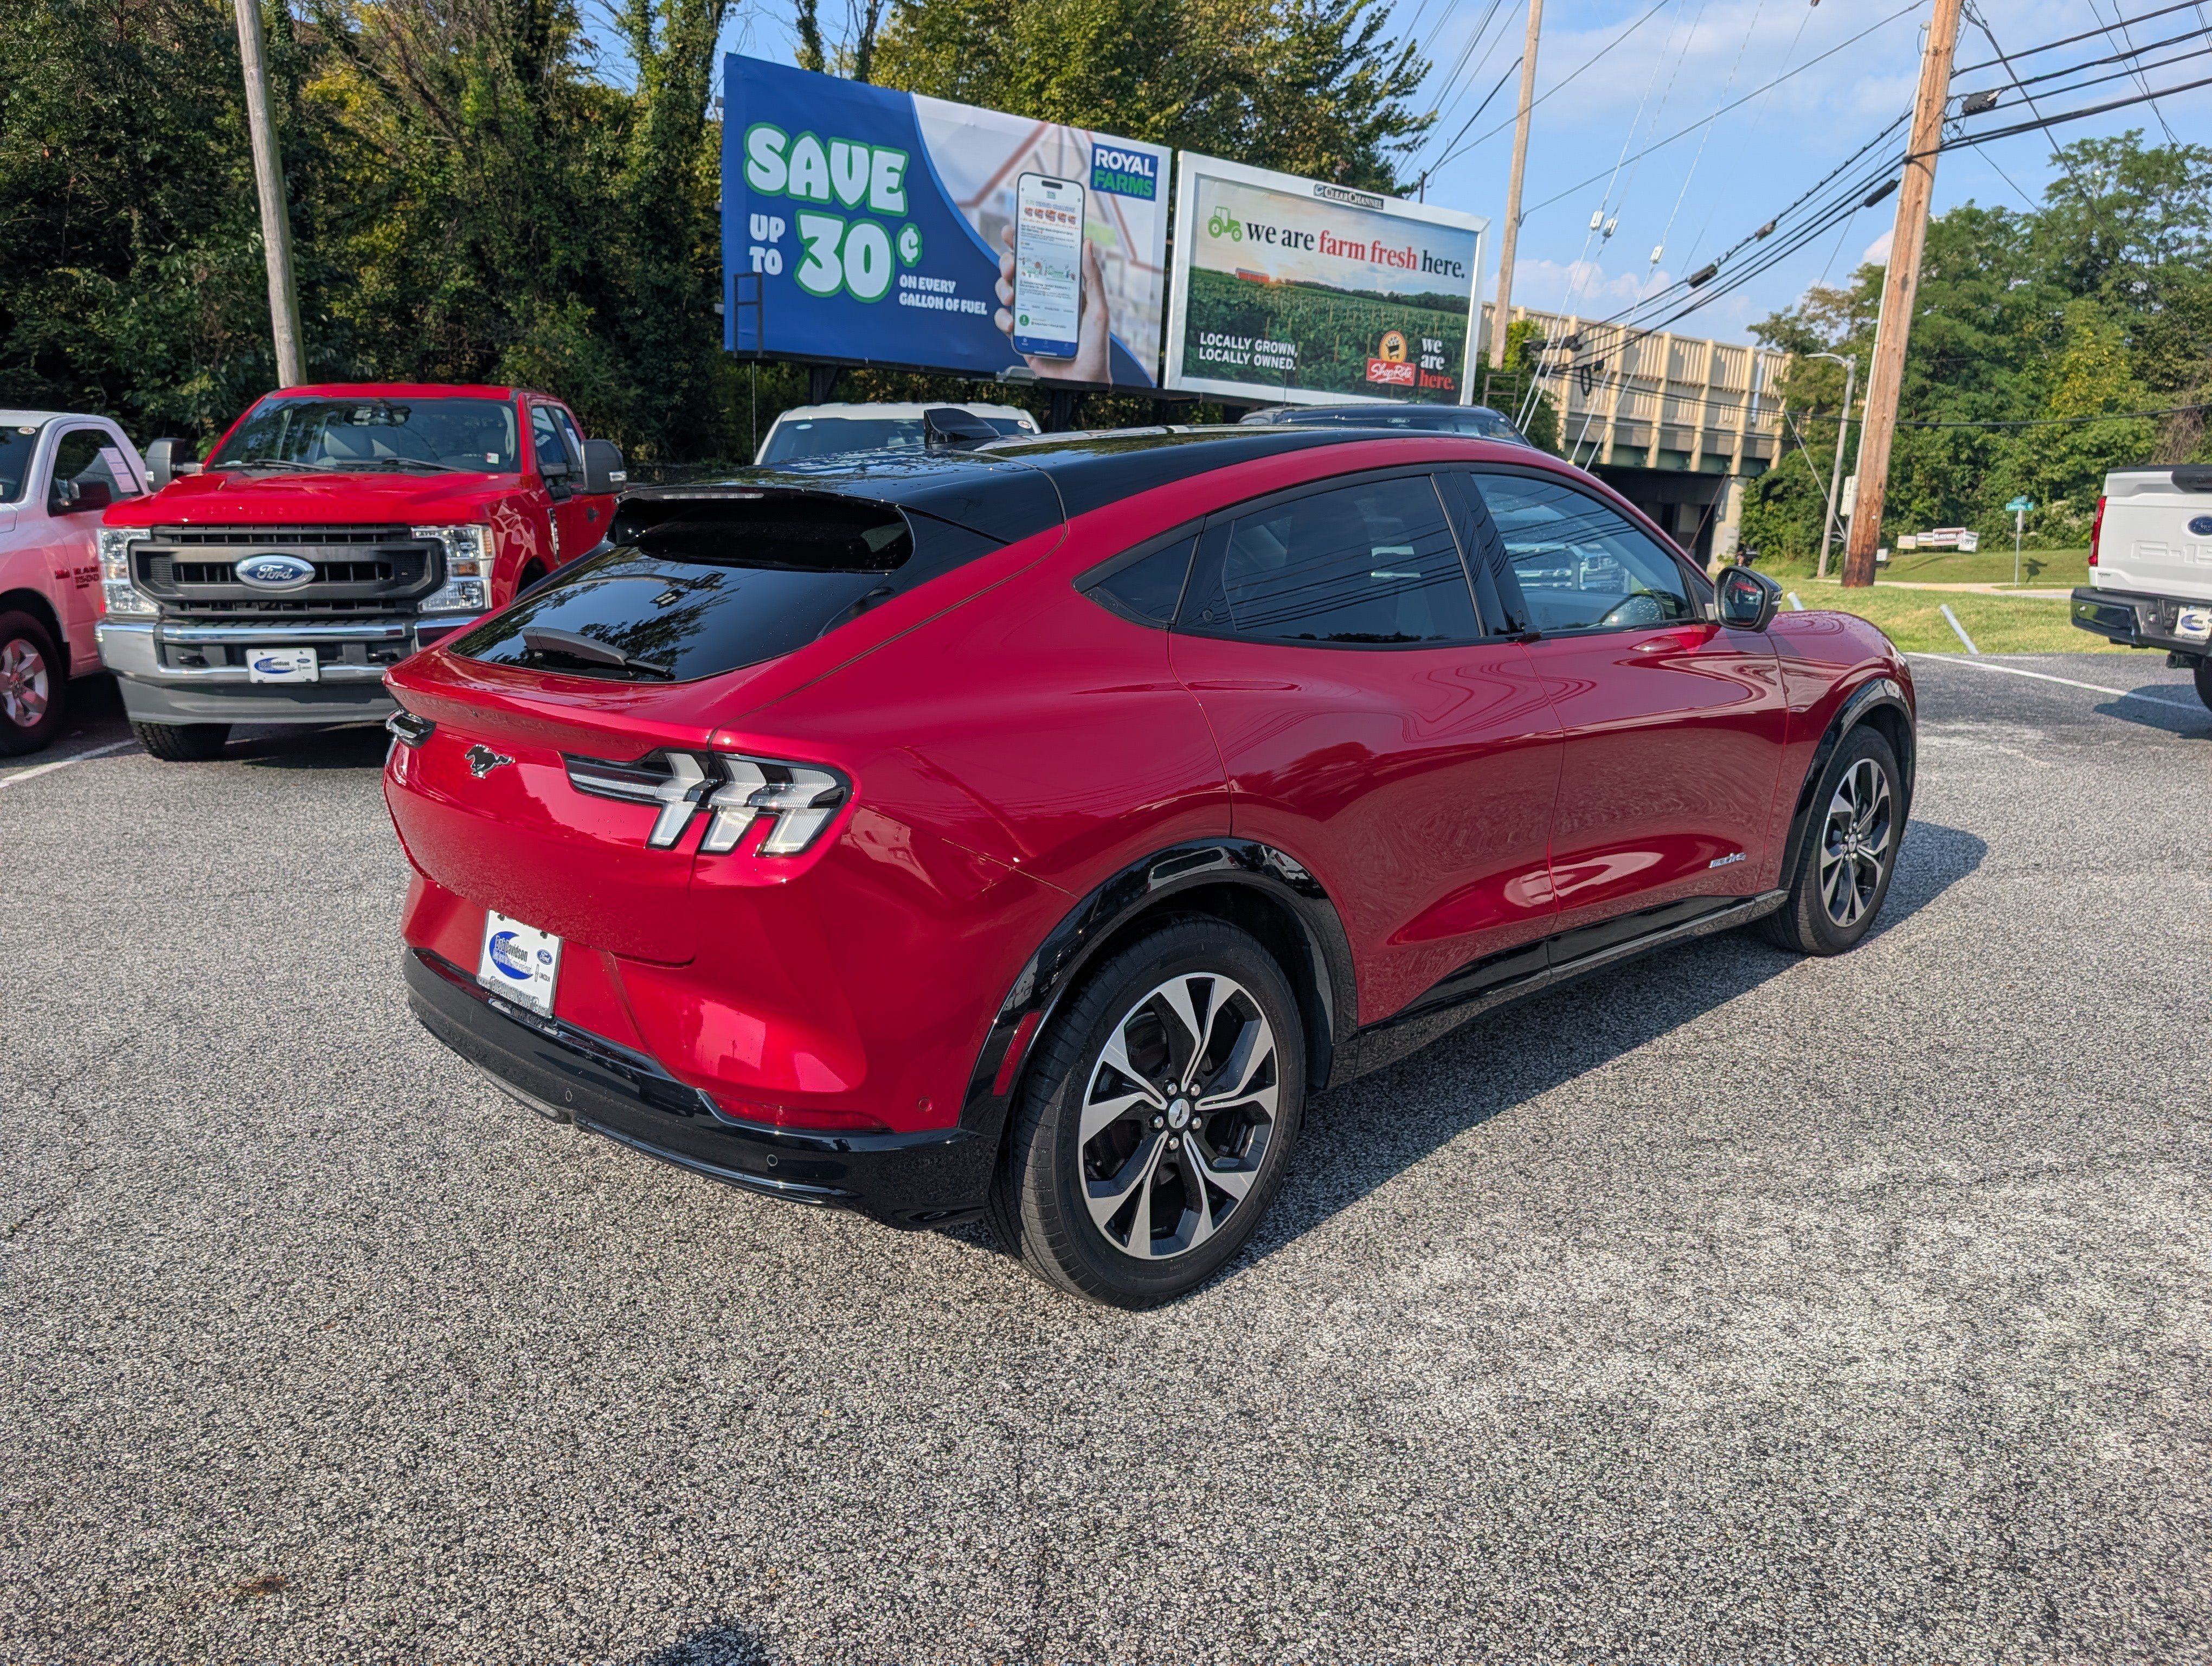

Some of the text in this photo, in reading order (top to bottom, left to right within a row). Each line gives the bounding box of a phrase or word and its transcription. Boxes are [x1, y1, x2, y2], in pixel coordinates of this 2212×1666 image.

[744, 124, 908, 215] SAVE
[1095, 148, 1155, 178] ROYAL
[1093, 170, 1153, 197] FARMS
[750, 213, 786, 243] UP
[749, 246, 783, 275] TO
[1246, 221, 1465, 279] we are farm fresh here.
[899, 274, 956, 294] ON EVERY
[898, 292, 988, 316] GALLON OF FUEL
[1200, 331, 1299, 358] LOCALLY GROWN,
[1422, 337, 1443, 354] we
[1199, 347, 1296, 371] LOCALLY OWNED.
[1420, 354, 1445, 370] are
[1369, 362, 1413, 383] ShopRite
[1419, 369, 1456, 390] here.
[75, 574, 100, 584] 1500
[256, 564, 293, 580] Ford
[495, 934, 506, 952] Bob
[505, 939, 529, 963] Davidson
[539, 951, 551, 964] Ford
